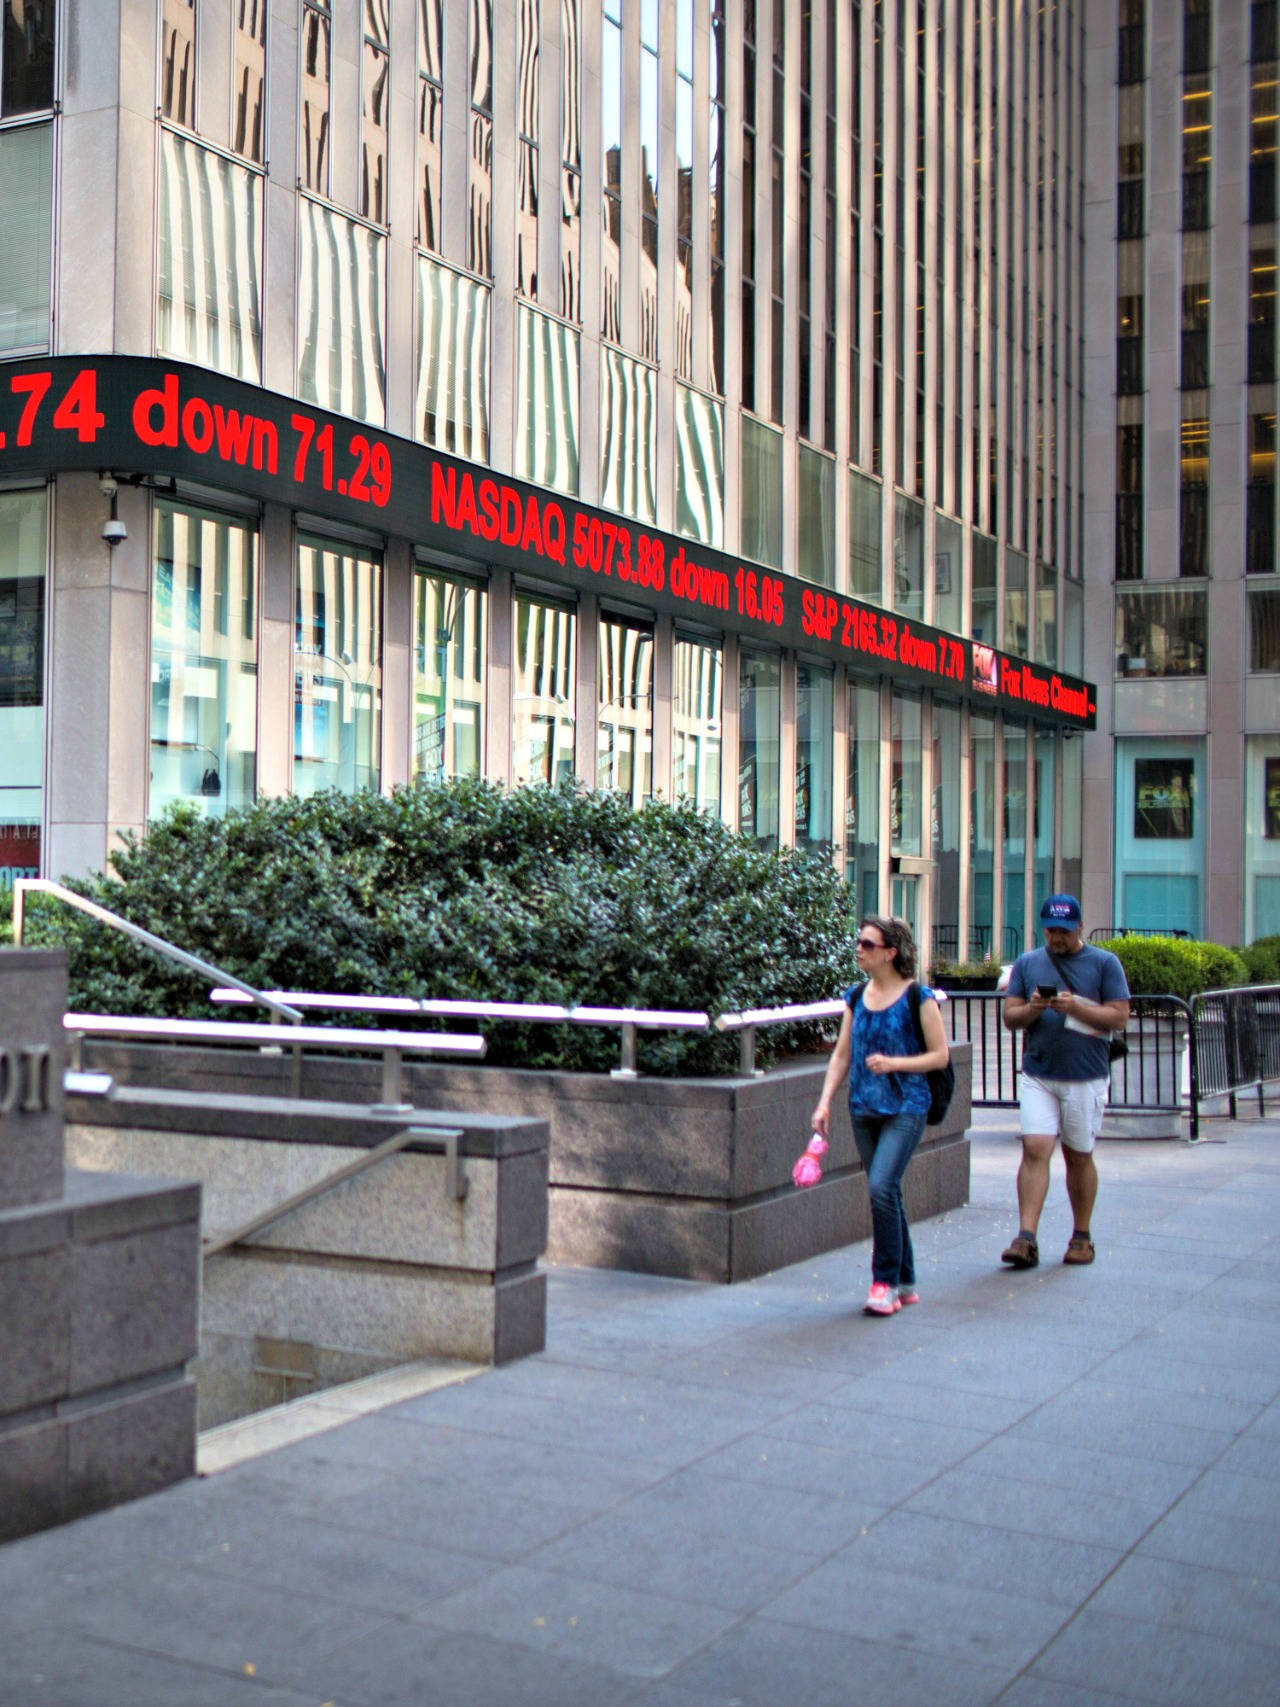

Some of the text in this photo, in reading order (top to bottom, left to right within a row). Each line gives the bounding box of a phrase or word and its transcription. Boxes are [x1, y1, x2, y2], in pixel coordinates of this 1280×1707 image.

[132, 373, 278, 475] down
[291, 413, 392, 508] 71.29
[431, 461, 566, 567] NASDAQ
[572, 512, 665, 592] 5073.88
[670, 547, 730, 611] down
[735, 567, 785, 627] 16.05
[801, 589, 839, 641] S&P
[841, 603, 898, 662] 2165.32
[899, 624, 937, 673] down
[938, 636, 965, 682] 7.70
[1000, 657, 1088, 719] Fox News Channel
